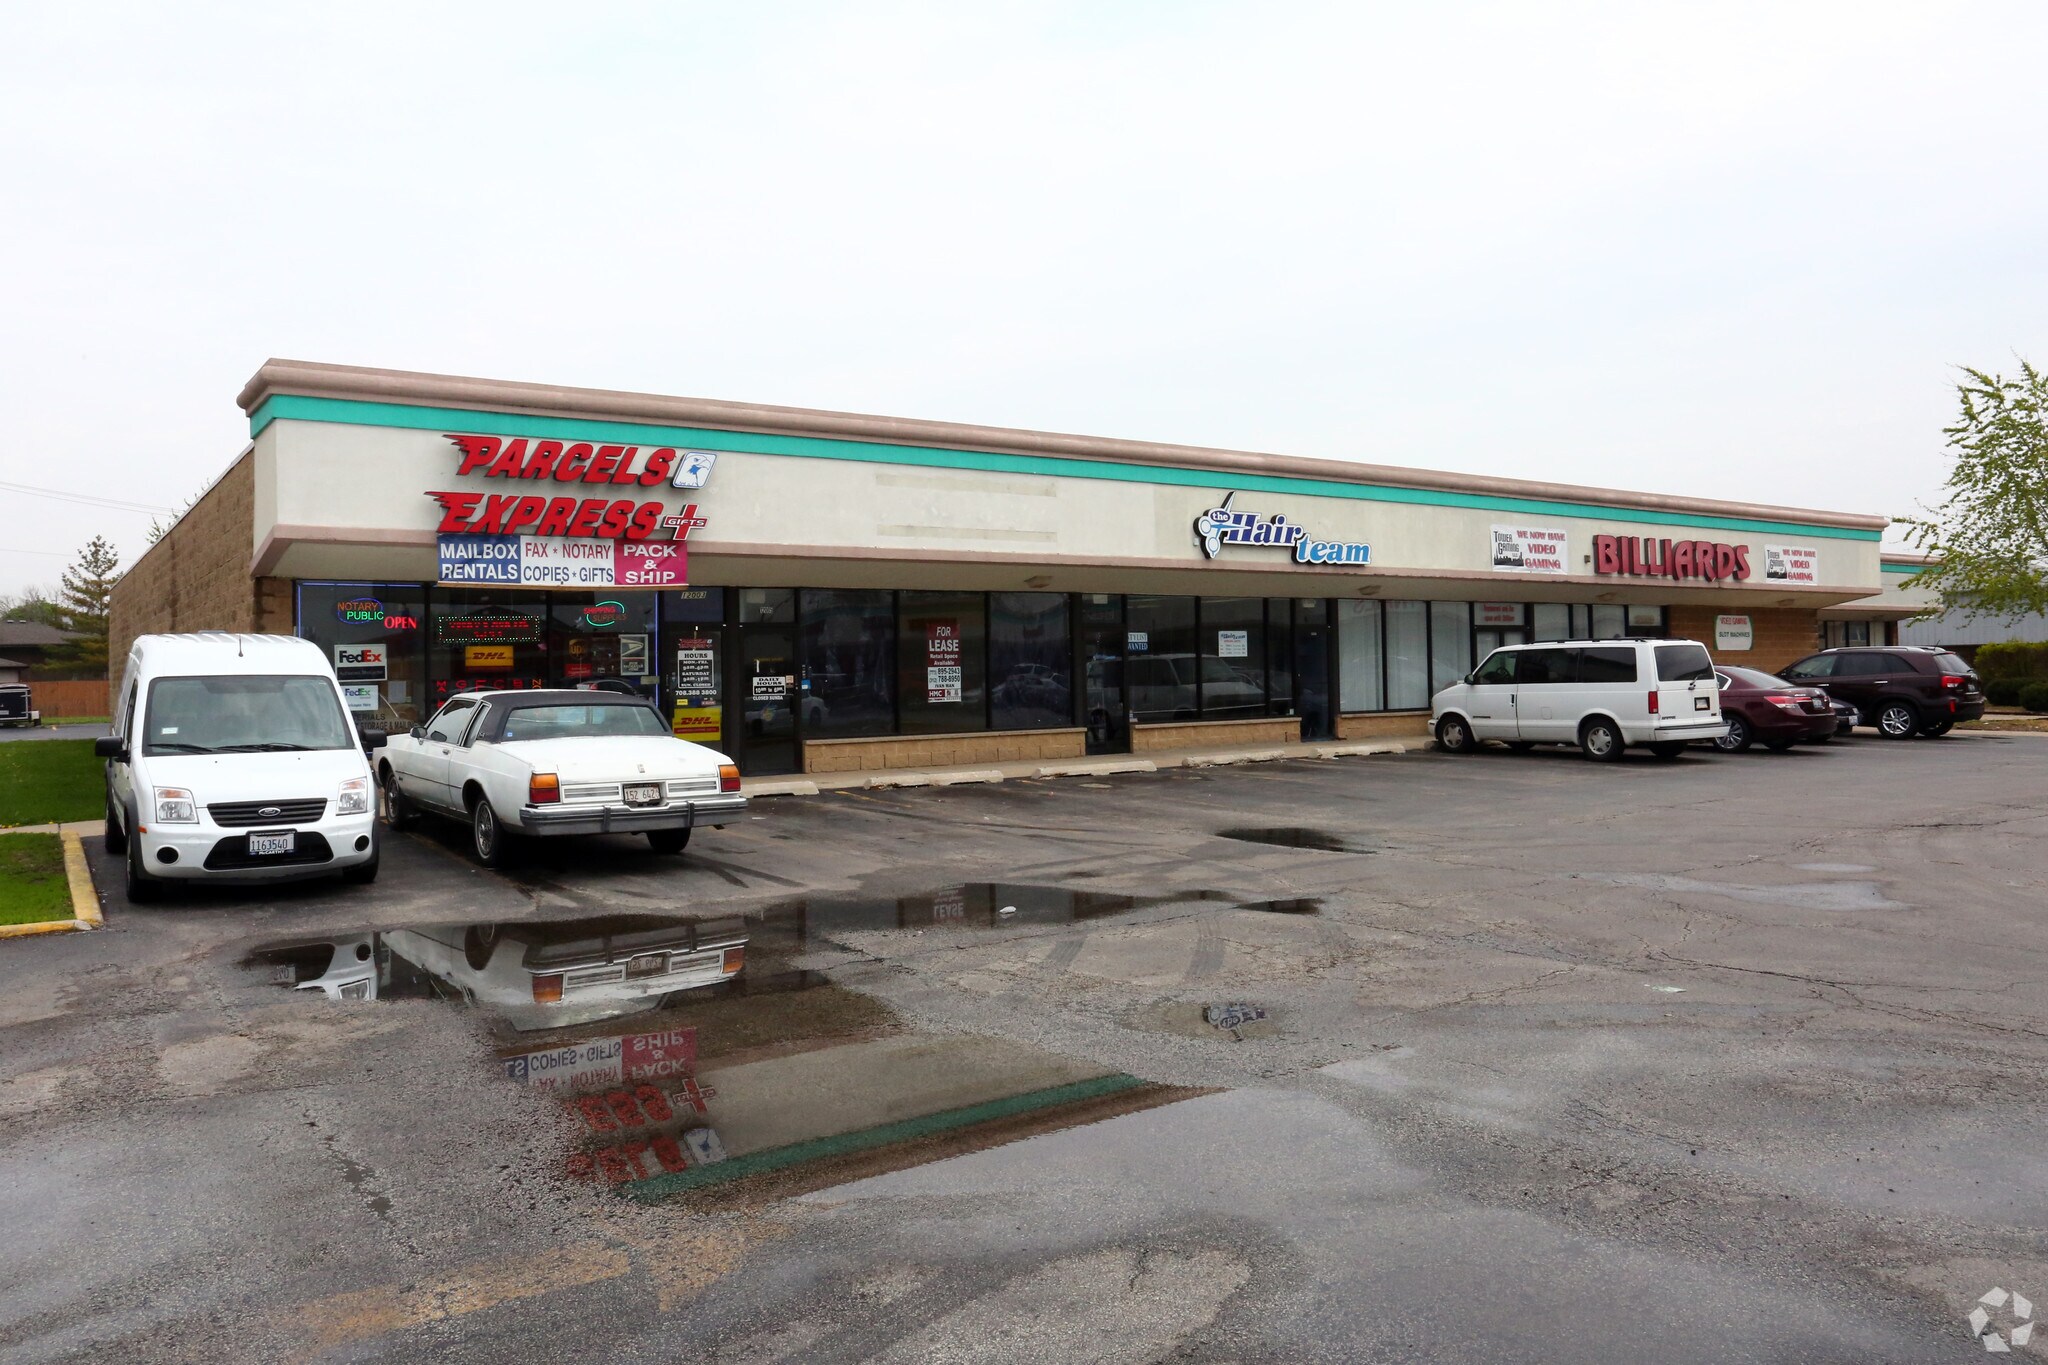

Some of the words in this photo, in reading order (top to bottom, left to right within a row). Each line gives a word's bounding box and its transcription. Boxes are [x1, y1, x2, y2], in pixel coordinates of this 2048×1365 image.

[442, 434, 676, 486] PARCELS
[424, 491, 664, 539] EXPRESS
[1211, 511, 1229, 521] the
[668, 518, 706, 527] GIFTS
[1226, 511, 1302, 546] Hair
[1517, 530, 1528, 539] WE
[440, 543, 518, 560] MAILBOX
[525, 543, 548, 558] FAX
[562, 544, 611, 560] NOTARY
[623, 544, 677, 558] PACK
[1298, 536, 1370, 562] team
[1527, 544, 1556, 554] VIDEO
[1525, 558, 1561, 569] GAMING
[1594, 535, 1750, 582] BILLIARDS
[643, 559, 658, 570] &
[1790, 560, 1809, 569] VIDEO
[441, 564, 518, 580] RENTALS
[523, 566, 570, 583] COPIES
[579, 569, 614, 583] GIFTS
[625, 571, 676, 584] SHIP
[1788, 572, 1812, 581] GAMING
[338, 601, 378, 611] NOTARY
[346, 611, 384, 620] PUBLIC
[384, 616, 417, 629] OPEN
[936, 627, 951, 636] FOR
[929, 640, 959, 651] LEASE
[339, 650, 381, 663] FedEx
[345, 688, 370, 696] FedEx
[251, 839, 287, 850] 1163540
